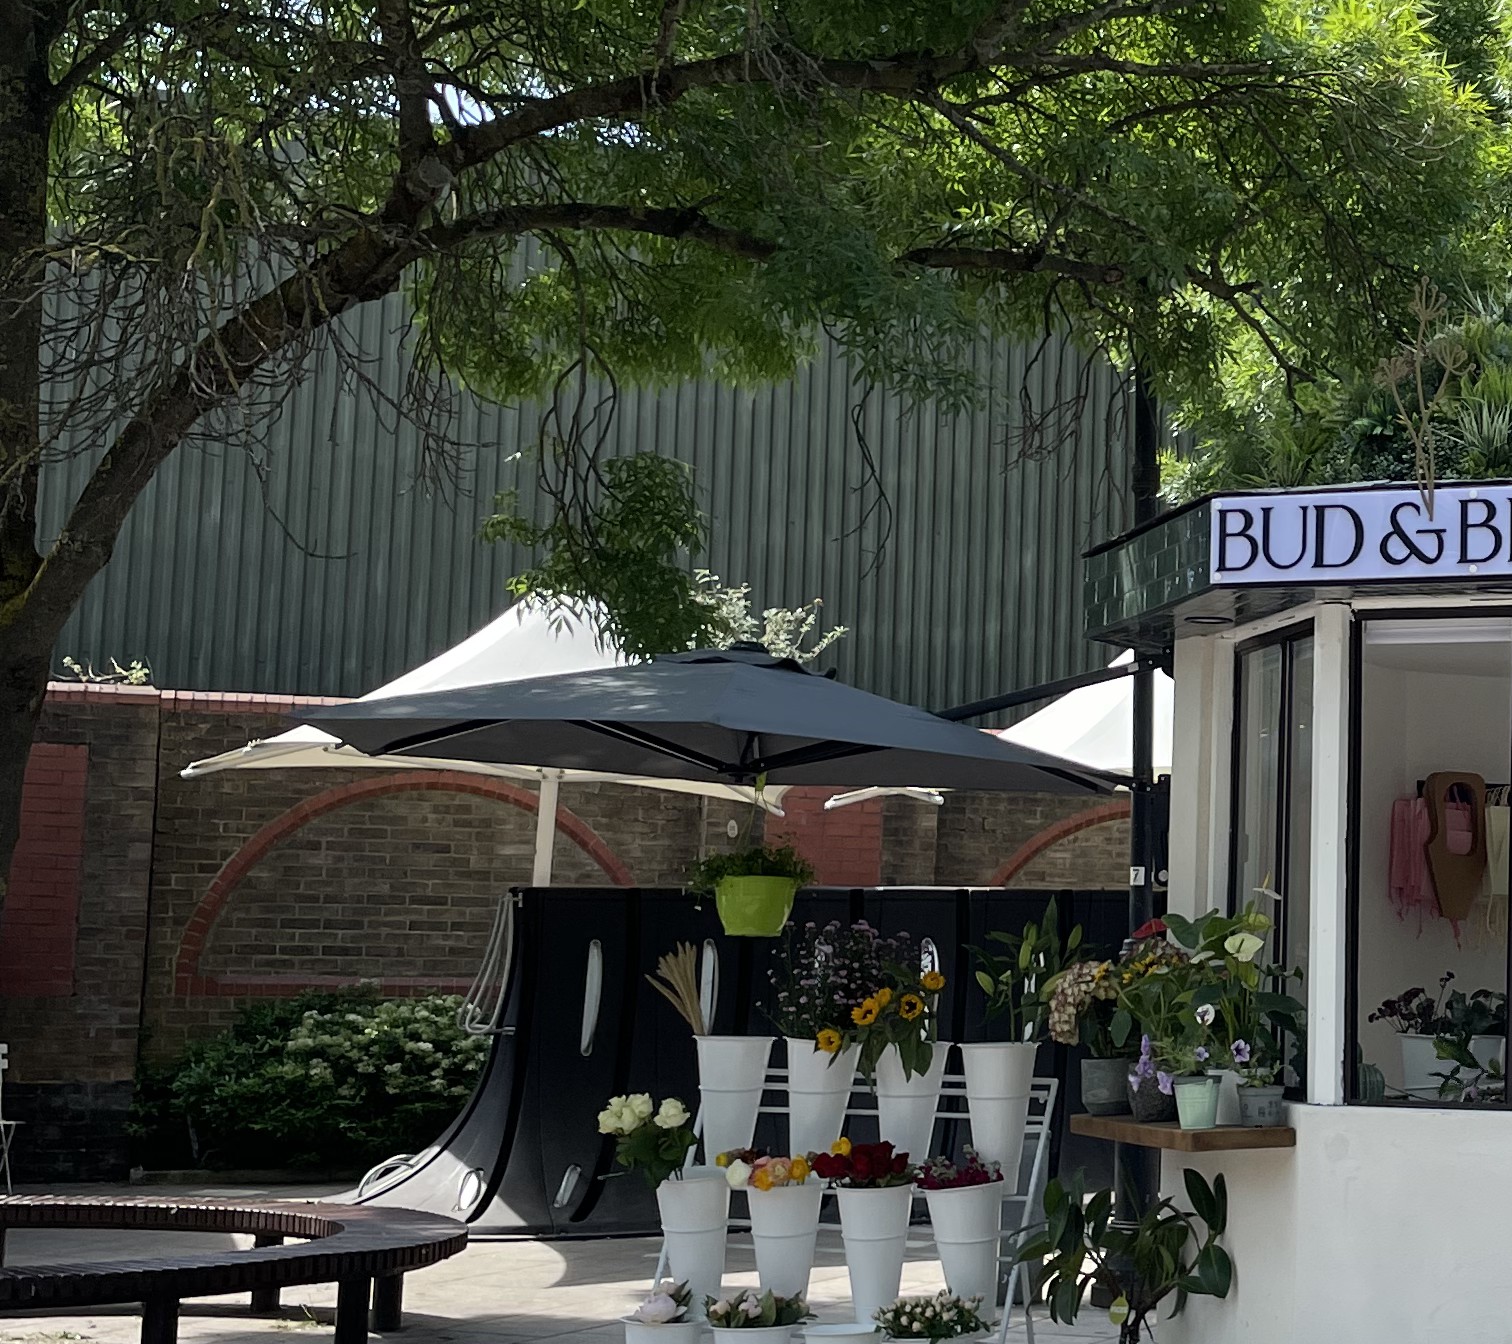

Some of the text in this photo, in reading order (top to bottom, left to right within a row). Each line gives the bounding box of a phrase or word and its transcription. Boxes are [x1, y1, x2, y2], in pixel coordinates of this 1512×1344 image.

[1215, 503, 1365, 573] BUD
[1379, 501, 1447, 566] &
[1132, 868, 1140, 883] 7
